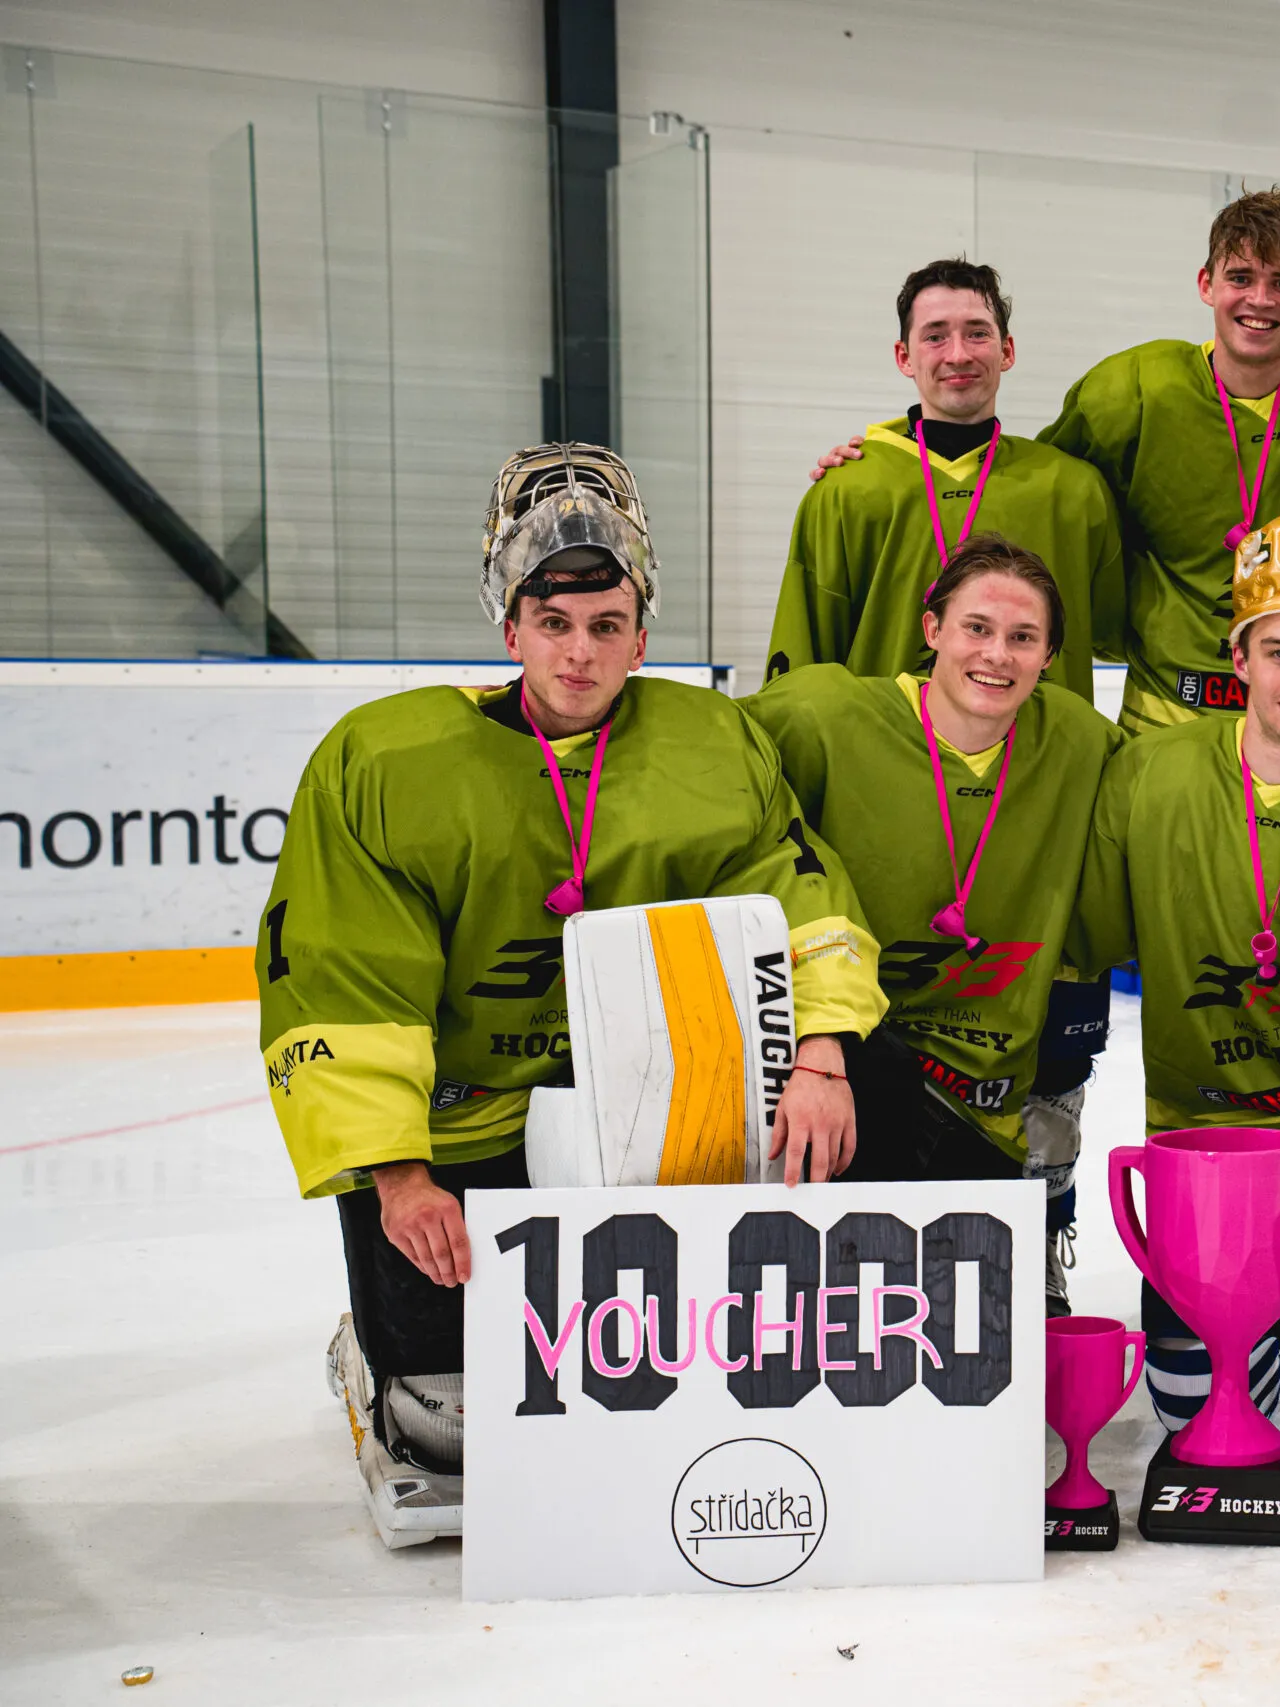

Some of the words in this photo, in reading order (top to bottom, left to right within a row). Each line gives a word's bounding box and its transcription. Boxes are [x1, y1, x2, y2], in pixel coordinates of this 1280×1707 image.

[1182, 674, 1197, 702] FOR
[1205, 676, 1249, 706] GA
[777, 817, 827, 878] 1
[267, 899, 290, 984] 1
[943, 1007, 981, 1023] THAN
[1064, 1020, 1104, 1035] CCM
[523, 1286, 945, 1380] VOUCHER
[690, 1488, 813, 1534] střídačka
[1075, 1526, 1109, 1536] HOCKEY
